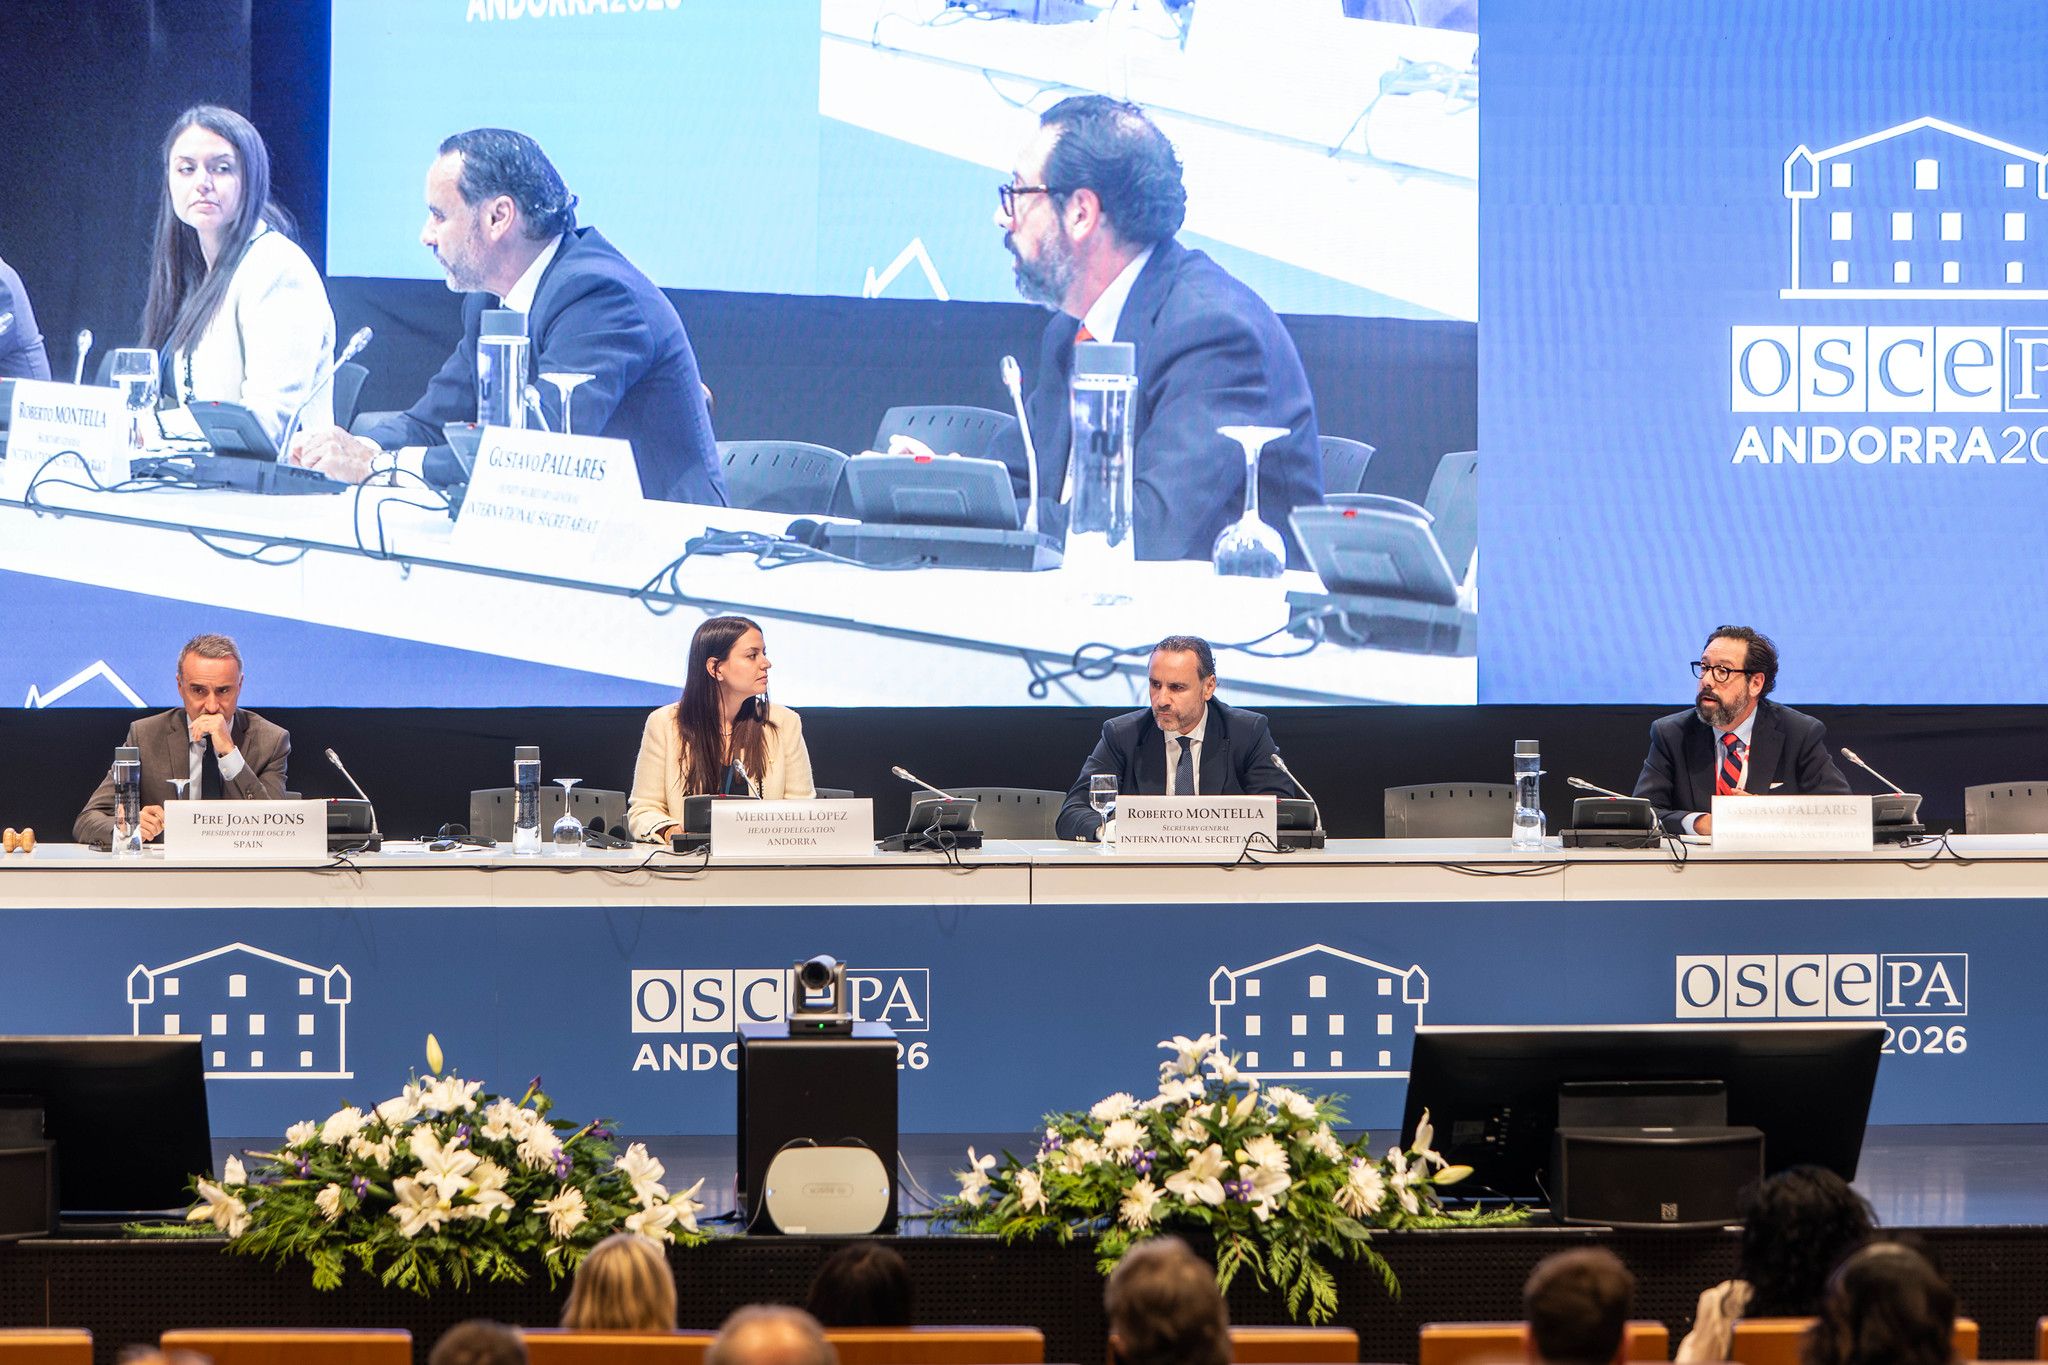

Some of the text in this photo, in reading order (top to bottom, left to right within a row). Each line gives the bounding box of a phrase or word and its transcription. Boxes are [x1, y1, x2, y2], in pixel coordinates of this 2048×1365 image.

[55, 406, 107, 428] MONTELLA
[489, 446, 607, 481] GUSTAVO PALLARES
[1127, 808, 1264, 819] ROBERTO MONTELLA
[1787, 804, 1858, 816] PALLARES
[193, 813, 305, 827] PERE JOAN PONS
[736, 811, 805, 822] MERITXELL
[748, 826, 836, 834] HEAD OF DELEGATION
[233, 840, 264, 848] SPAIN
[767, 837, 817, 846] ANDORRA
[1121, 835, 1202, 844] INTERNATIONAL
[1886, 961, 1963, 1007] PA
[636, 976, 924, 1023] OSC PA
